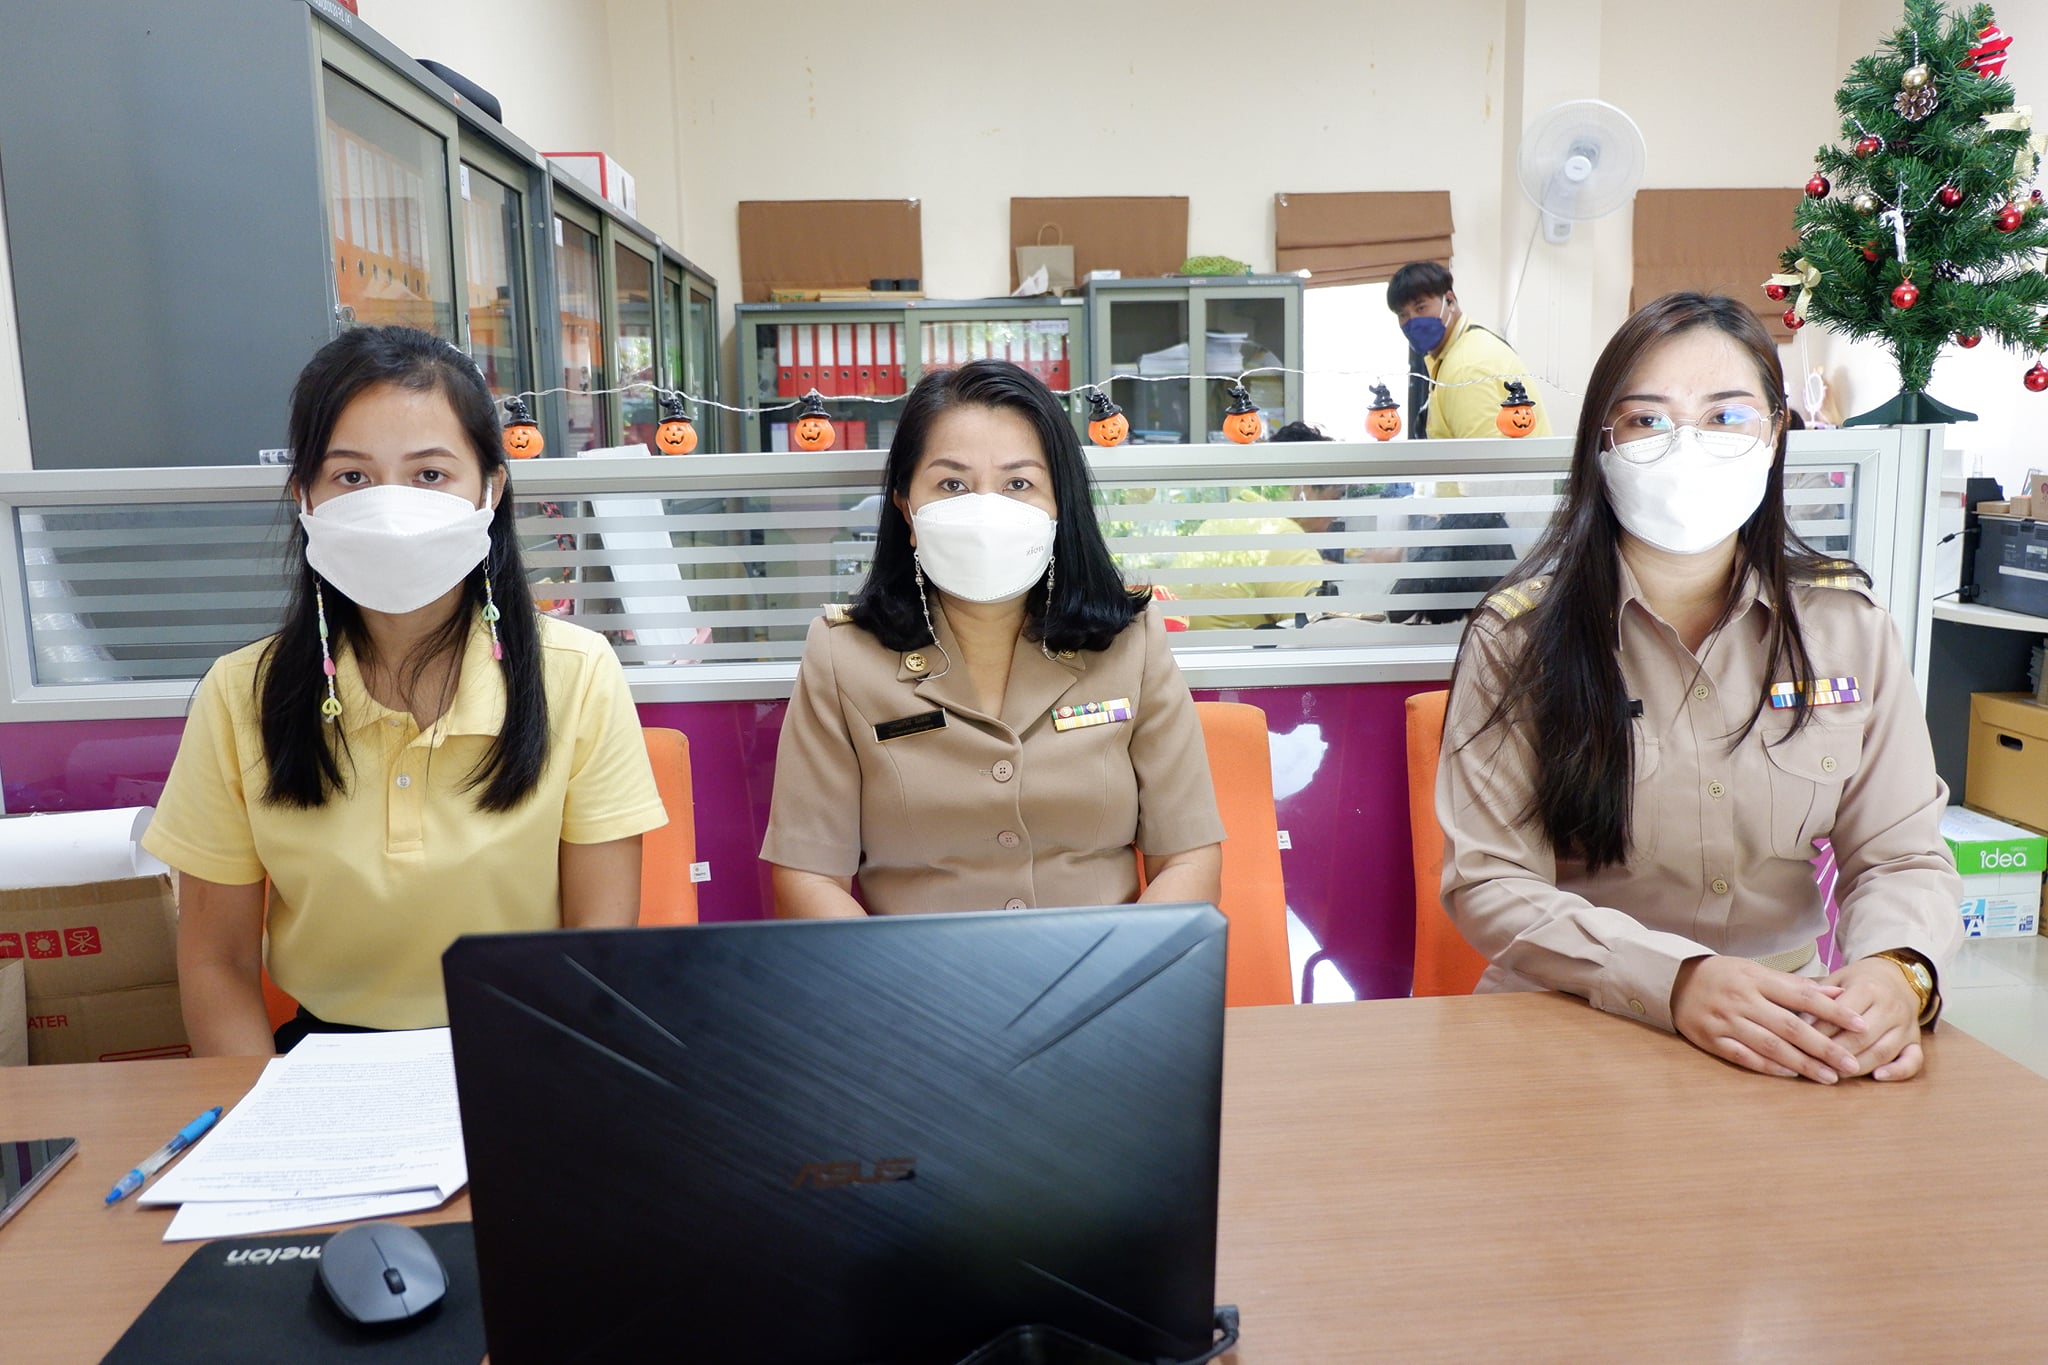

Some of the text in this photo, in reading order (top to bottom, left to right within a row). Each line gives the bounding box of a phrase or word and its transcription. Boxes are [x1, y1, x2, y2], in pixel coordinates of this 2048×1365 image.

[1980, 848, 2027, 869] idea
[28, 1014, 69, 1029] ATER
[790, 1157, 917, 1188] ASUS
